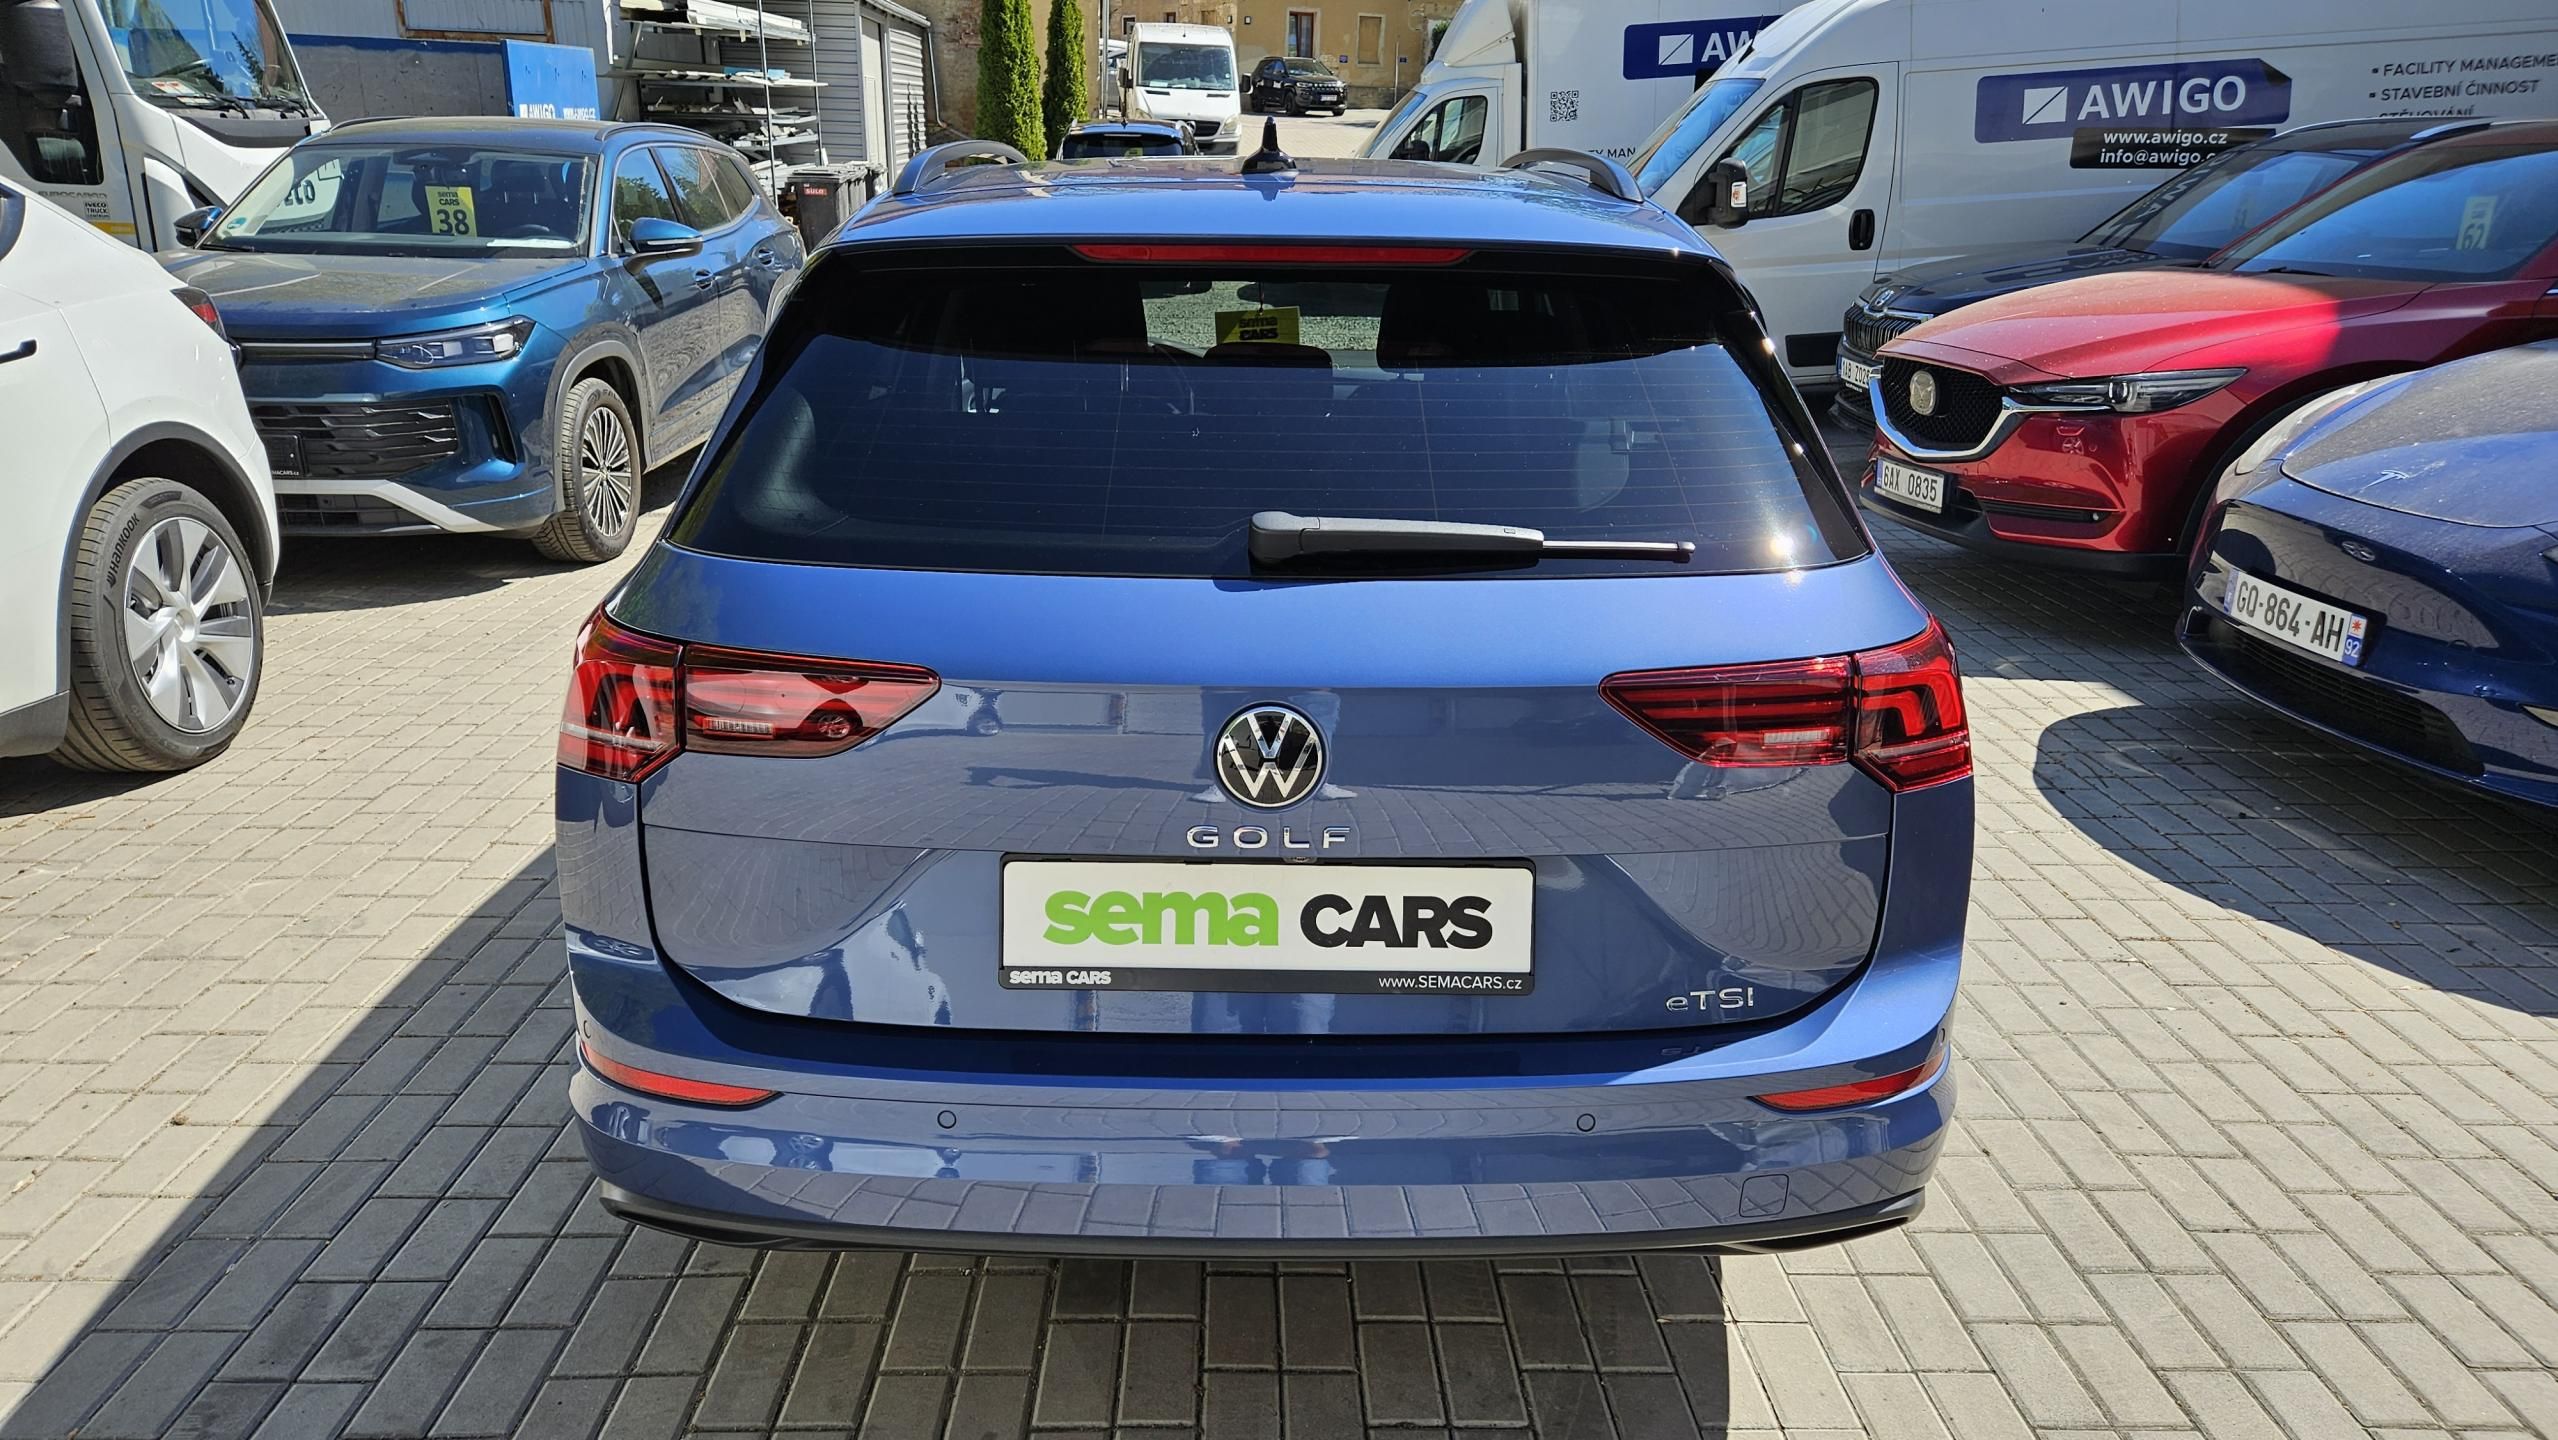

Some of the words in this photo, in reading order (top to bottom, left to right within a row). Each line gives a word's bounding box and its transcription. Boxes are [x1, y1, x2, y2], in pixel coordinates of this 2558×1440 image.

[2383, 58, 2457, 77] FACILITY
[2459, 53, 2558, 72] MANAGEME
[2077, 75, 2246, 121] AWIGO
[2380, 81, 2463, 101] STAVEBNÍ
[2465, 79, 2541, 97] ČINNOST
[2103, 129, 2228, 147] www.awigo.cz
[2100, 149, 2215, 166] info@awigo.c
[436, 208, 470, 235] 38
[1883, 465, 1901, 492] 6AX
[1907, 473, 1938, 502] 0835
[2344, 638, 2361, 658] 92
[1186, 824, 1351, 849] GOLF
[1042, 890, 1279, 947] sema
[1299, 893, 1493, 950] CARS
[1009, 970, 1063, 985] sema
[1065, 970, 1112, 985] CARS
[1378, 975, 1522, 990] www.SEMACARS.cz
[1665, 987, 1754, 1012] eTSI
